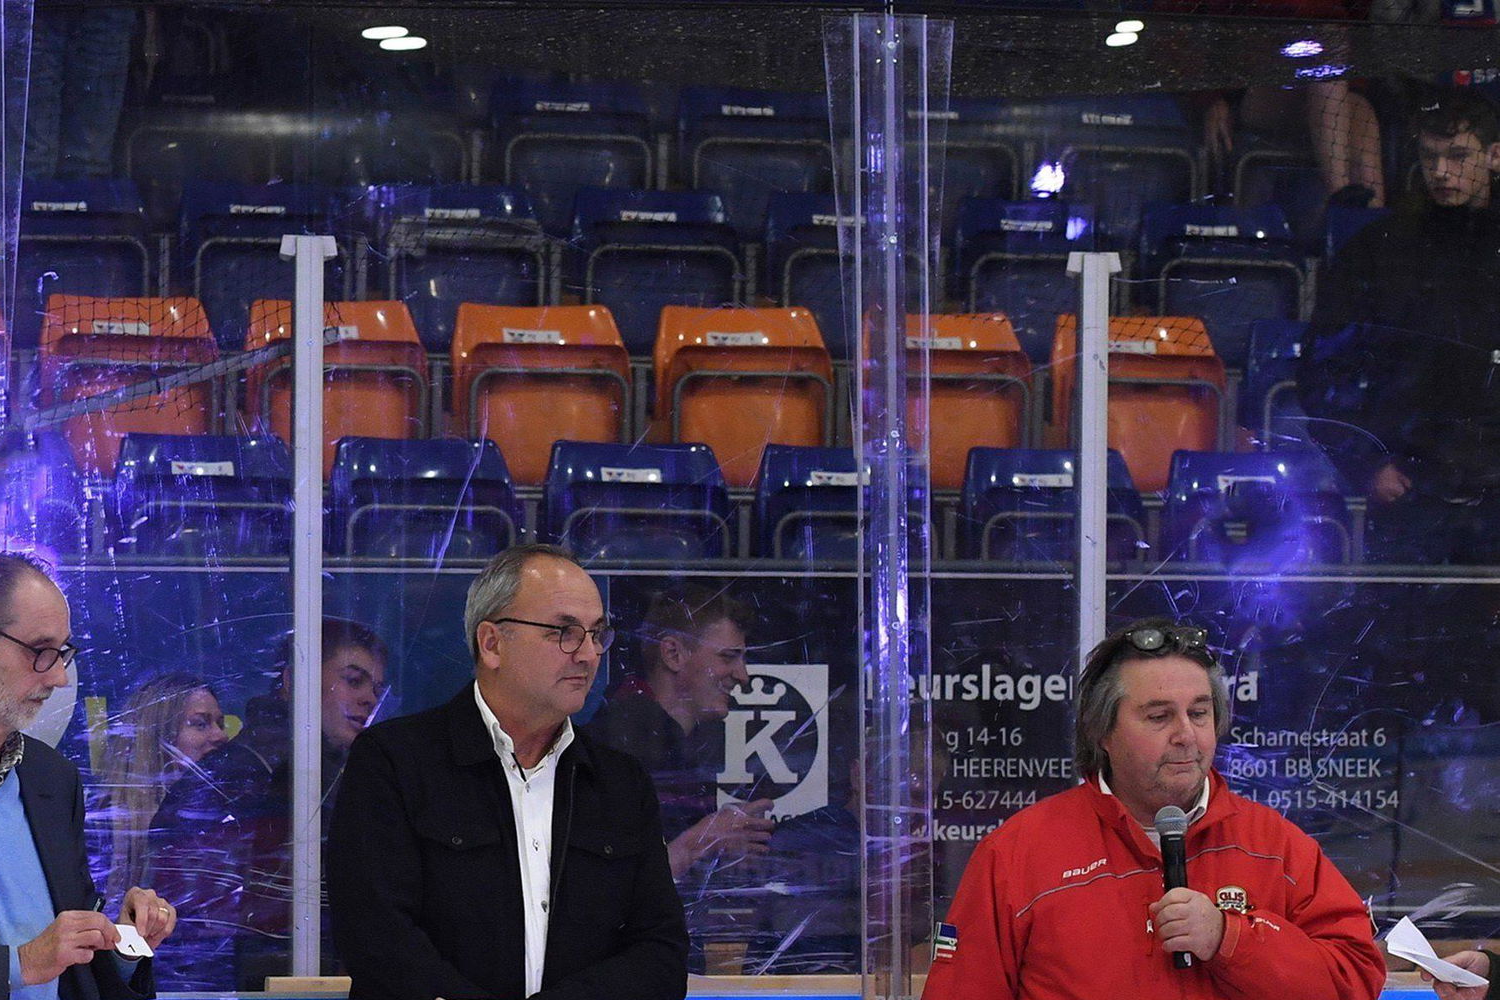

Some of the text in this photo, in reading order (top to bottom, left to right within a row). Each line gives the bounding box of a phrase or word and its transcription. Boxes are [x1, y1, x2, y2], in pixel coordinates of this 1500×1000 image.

[967, 727, 1023, 747] 14-16
[1230, 726, 1387, 747] Scharnestraat 6
[953, 758, 1073, 778] HEERENVEE
[1230, 758, 1277, 777] 8601
[1316, 757, 1382, 778] SNEEK
[1268, 790, 1400, 809] 0515-414154
[1062, 858, 1107, 879] BAUER
